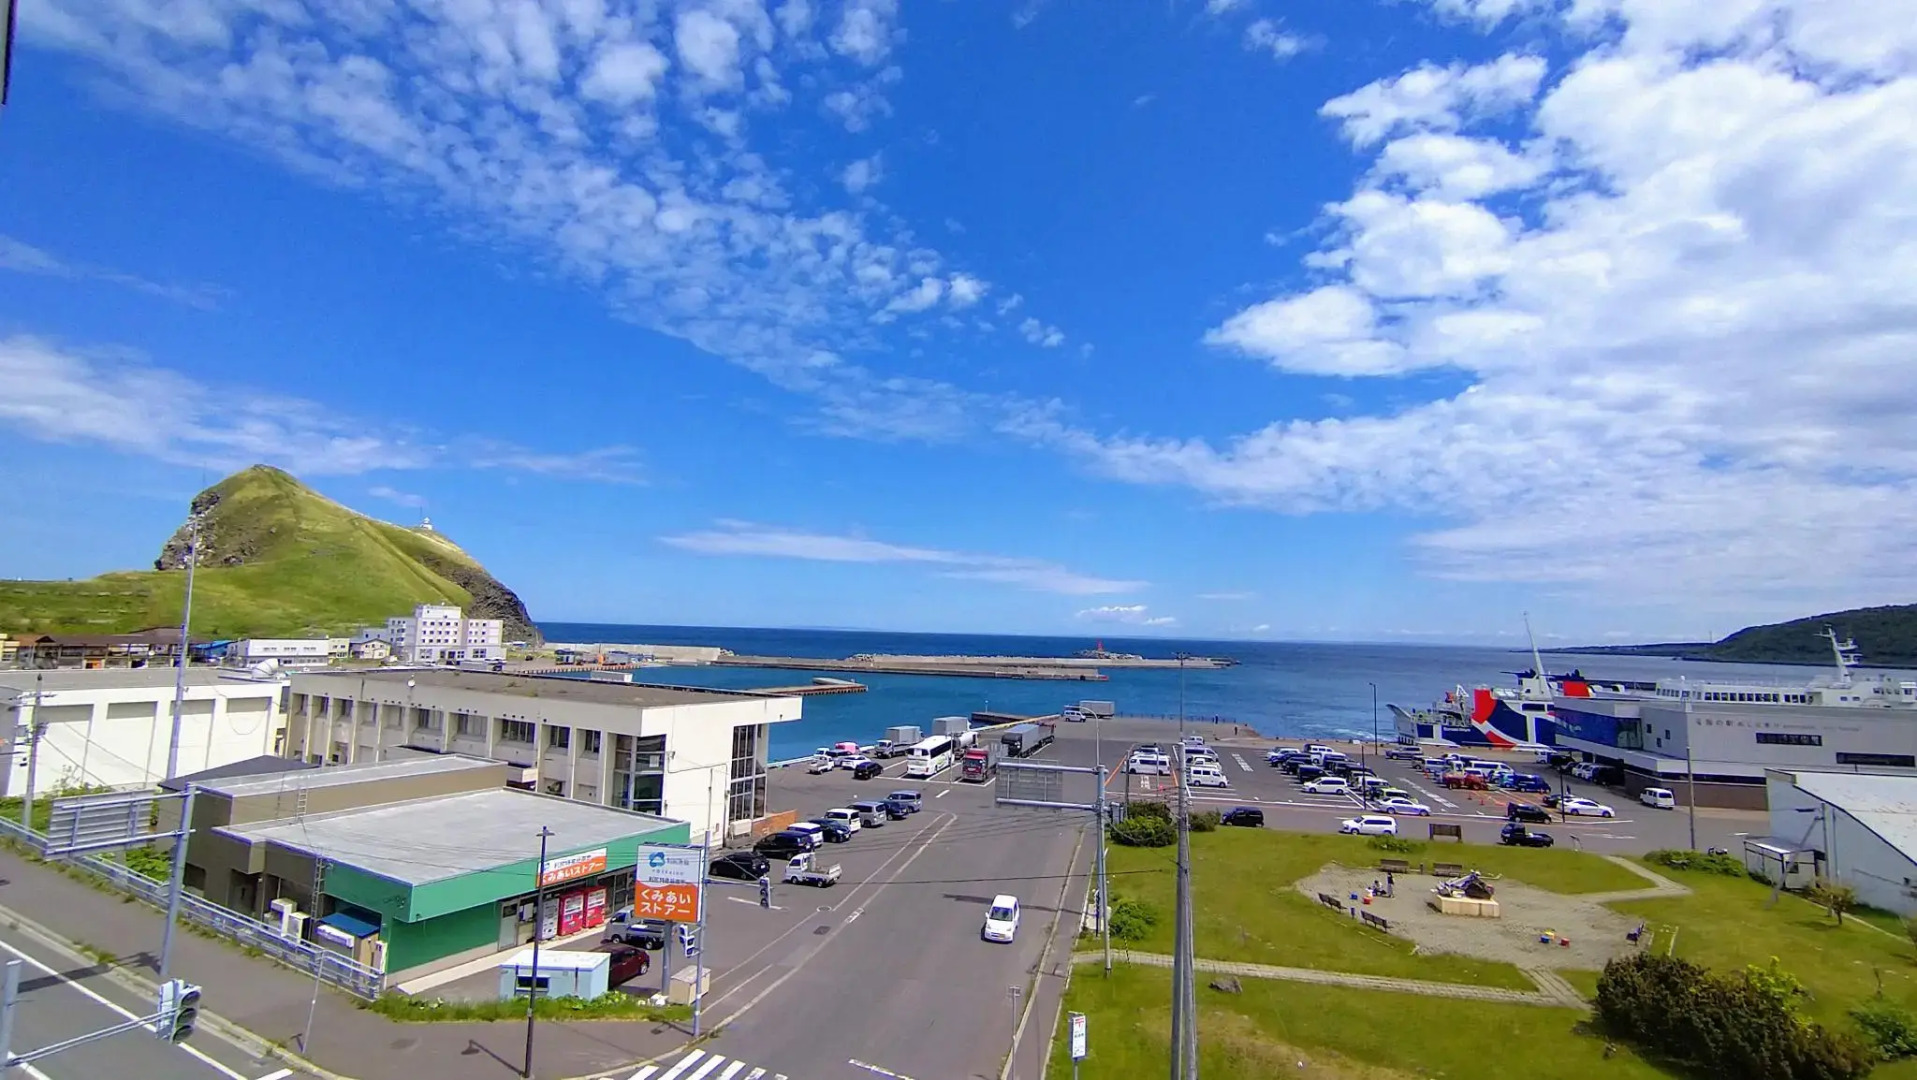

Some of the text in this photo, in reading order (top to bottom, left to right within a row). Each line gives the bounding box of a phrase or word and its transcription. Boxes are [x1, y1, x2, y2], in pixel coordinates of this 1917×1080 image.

[543, 862, 604, 882] くみあいストアー
[641, 889, 691, 904] くみあい
[641, 901, 691, 915] ストアー
